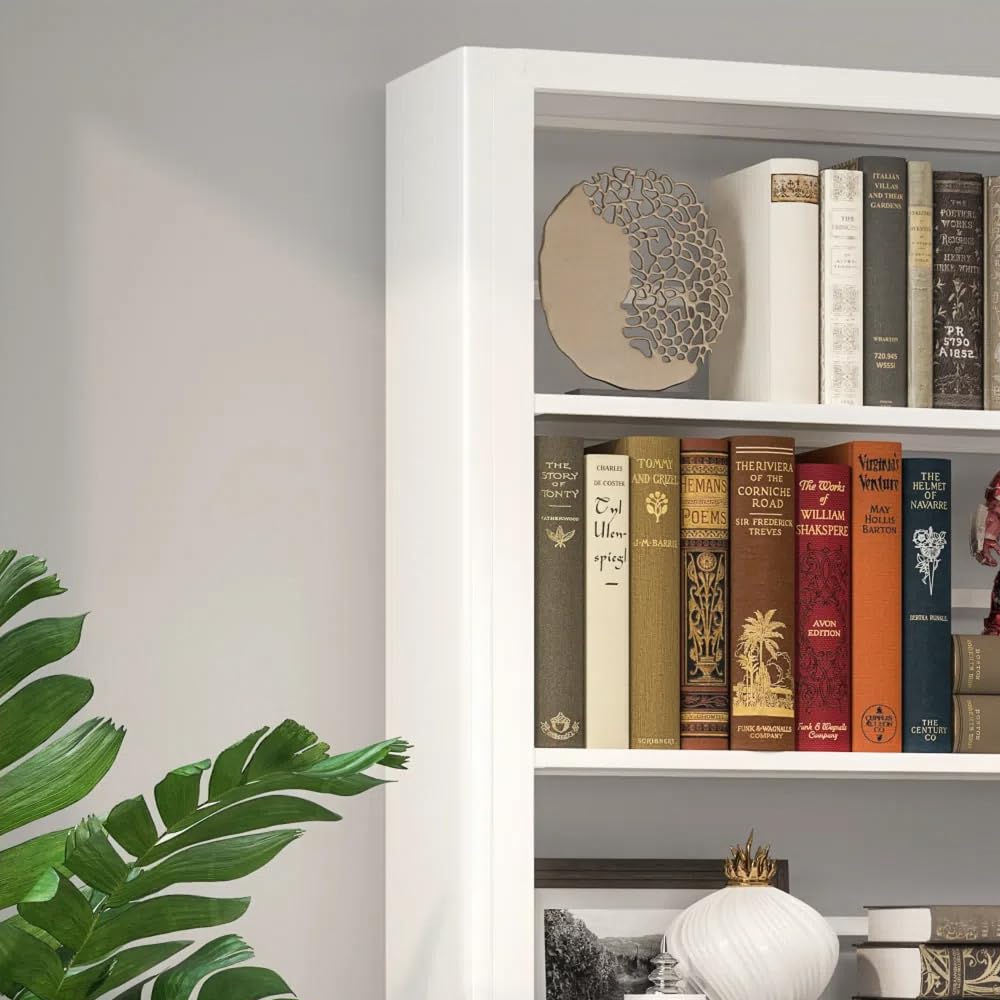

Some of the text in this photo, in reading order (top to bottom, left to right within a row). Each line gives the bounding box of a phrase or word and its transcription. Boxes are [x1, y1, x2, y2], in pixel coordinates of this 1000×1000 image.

[873, 172, 900, 180] ITALIAN
[940, 209, 976, 218] POETICAL
[941, 220, 973, 229] WORKS
[944, 253, 972, 261] HENRY
[944, 326, 964, 337] PR
[944, 337, 970, 346] 5790
[874, 352, 898, 360] 720.945
[637, 458, 673, 469] TOMMY
[858, 453, 899, 472] Virginia's
[542, 472, 579, 480] STORY
[632, 474, 649, 483] AND
[750, 474, 763, 482] OF
[920, 472, 940, 481] THE
[680, 478, 726, 493] HEMANS
[800, 480, 846, 492] The Works
[858, 474, 899, 492] Venture
[913, 481, 946, 491] HELMET
[541, 489, 580, 498] TONTY
[738, 487, 792, 497] CORNICHE
[752, 499, 784, 509] ROAD
[820, 494, 829, 505] of
[870, 505, 891, 514] MAY
[910, 502, 948, 510] NAVARRE
[682, 508, 726, 525] POEMS
[800, 510, 845, 520] WILLIAM
[865, 515, 896, 524] HOLLIS
[735, 518, 793, 527] SIR FREDERICK
[749, 528, 782, 536] TREVES
[795, 524, 849, 537] SHAKSPERE
[863, 525, 897, 534] BARTON
[813, 620, 837, 628] AVON
[911, 726, 948, 734] CENTURY
